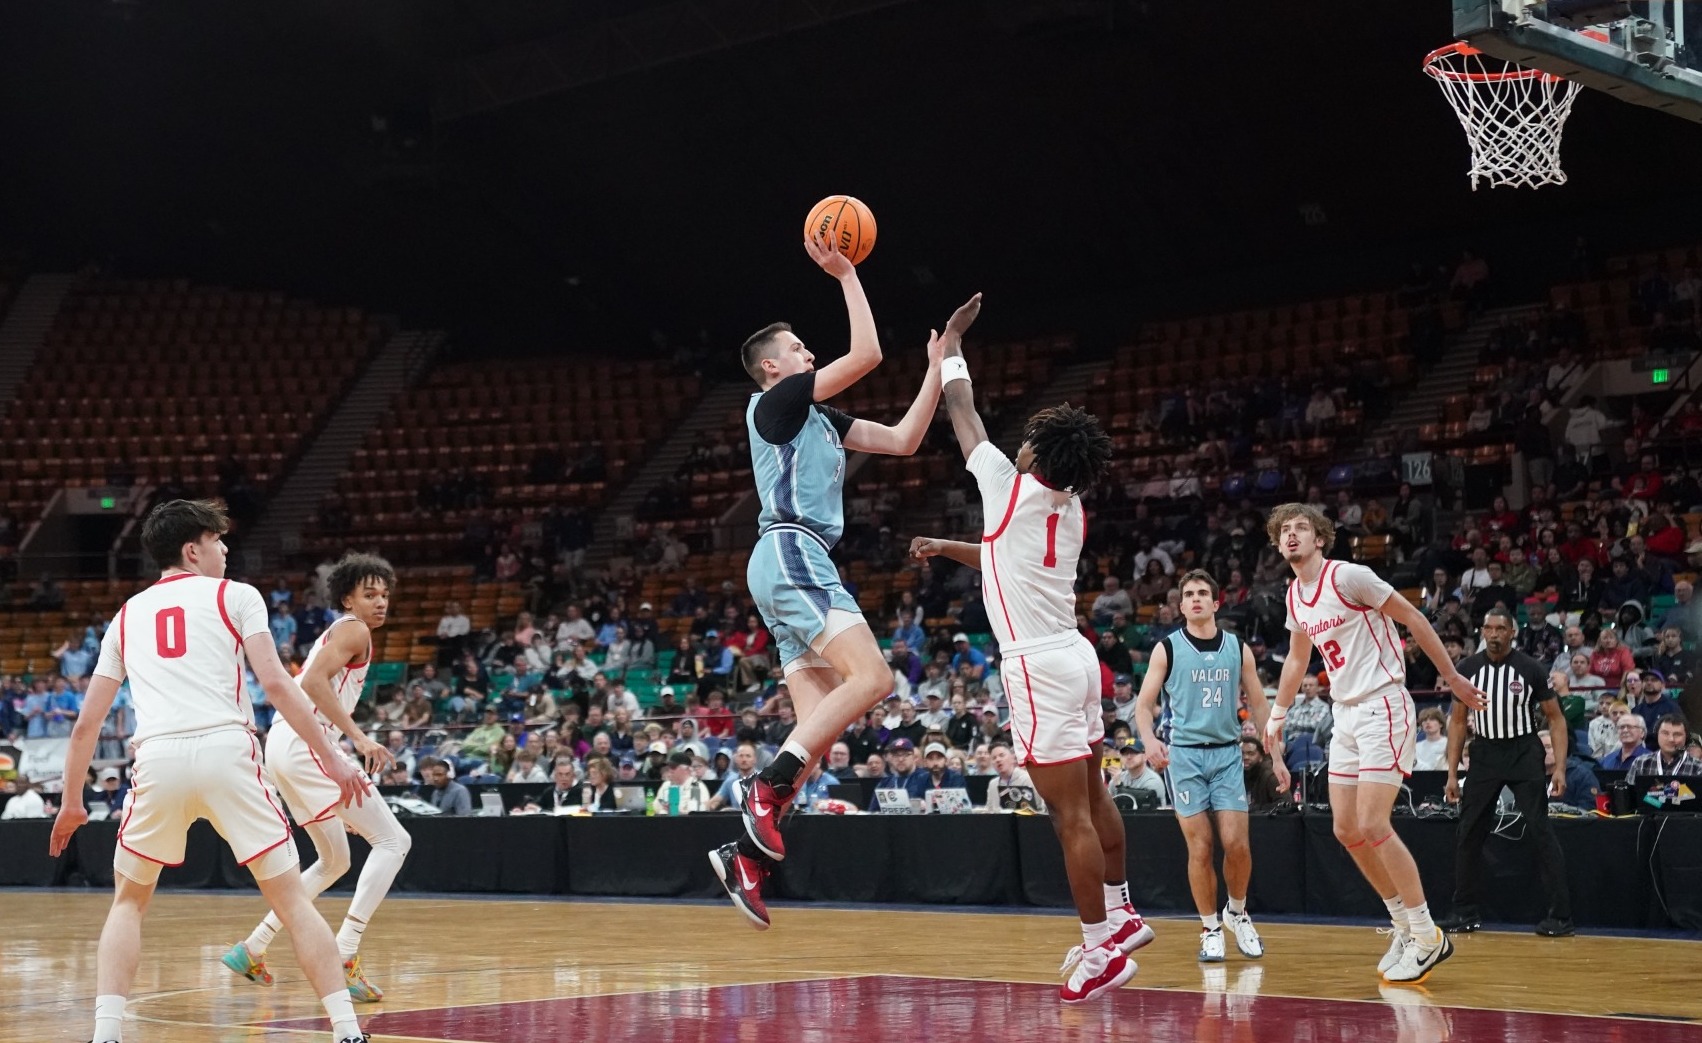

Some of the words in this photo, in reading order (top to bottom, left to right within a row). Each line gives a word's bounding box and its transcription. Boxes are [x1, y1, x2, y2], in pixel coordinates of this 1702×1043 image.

[1652, 368, 1668, 383] EXIT
[1407, 460, 1431, 479] 126
[1043, 513, 1060, 568] 1
[156, 606, 187, 658] 0
[1191, 669, 1230, 682] VALOR
[1202, 687, 1223, 708] 24
[1179, 790, 1190, 805] V
